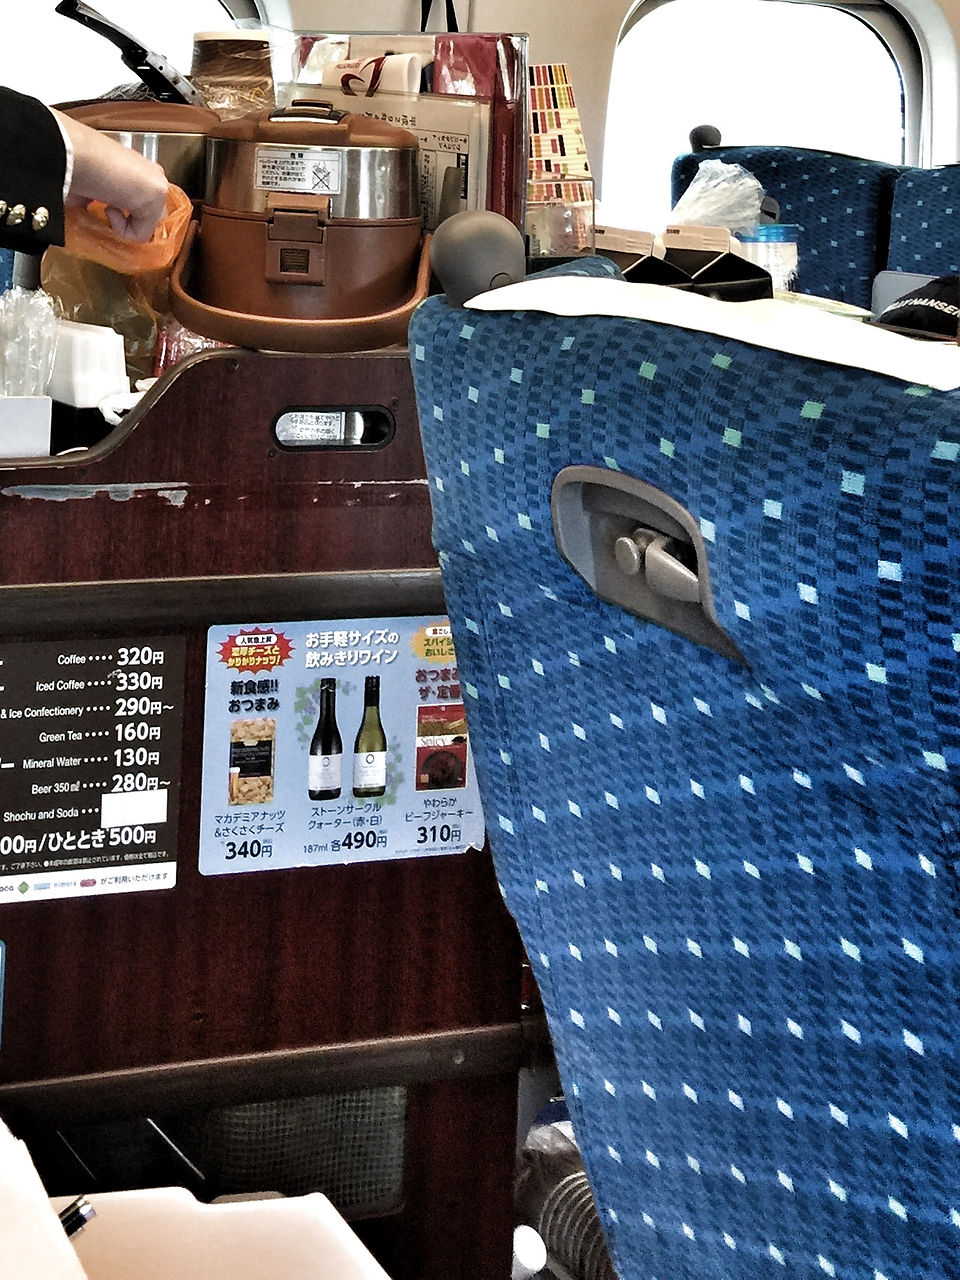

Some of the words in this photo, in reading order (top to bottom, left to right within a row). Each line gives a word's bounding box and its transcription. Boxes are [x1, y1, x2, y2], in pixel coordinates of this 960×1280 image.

[305, 628, 400, 649] お手軽サイズの
[57, 654, 86, 666] Coffee
[116, 646, 164, 666] 320円
[305, 648, 399, 669] 飲みきりワイン
[36, 680, 55, 692] Iced
[56, 678, 85, 690] Coffee
[115, 671, 163, 692] 330円
[0, 709, 7, 719] &
[9, 708, 23, 719] Ice
[24, 705, 84, 719] Confectionery
[228, 697, 280, 713] おつまみ
[39, 732, 65, 743] Green
[68, 731, 83, 741] Tea
[114, 721, 161, 742] 160円
[23, 758, 54, 769] Mineral
[56, 756, 81, 767] Water
[113, 747, 160, 767] 130円
[31, 784, 52, 795] Beer
[311, 803, 382, 817] ストーンサークル
[423, 797, 458, 808] やわらか
[3, 810, 36, 822] Shochu
[38, 809, 55, 820] and
[56, 808, 79, 819] Soda
[214, 810, 286, 825] マカデミアナッツ
[405, 808, 474, 822] ビーフジャーキー
[417, 824, 462, 844] 310円
[225, 839, 273, 860] 340円
[303, 843, 329, 854] 187ml
